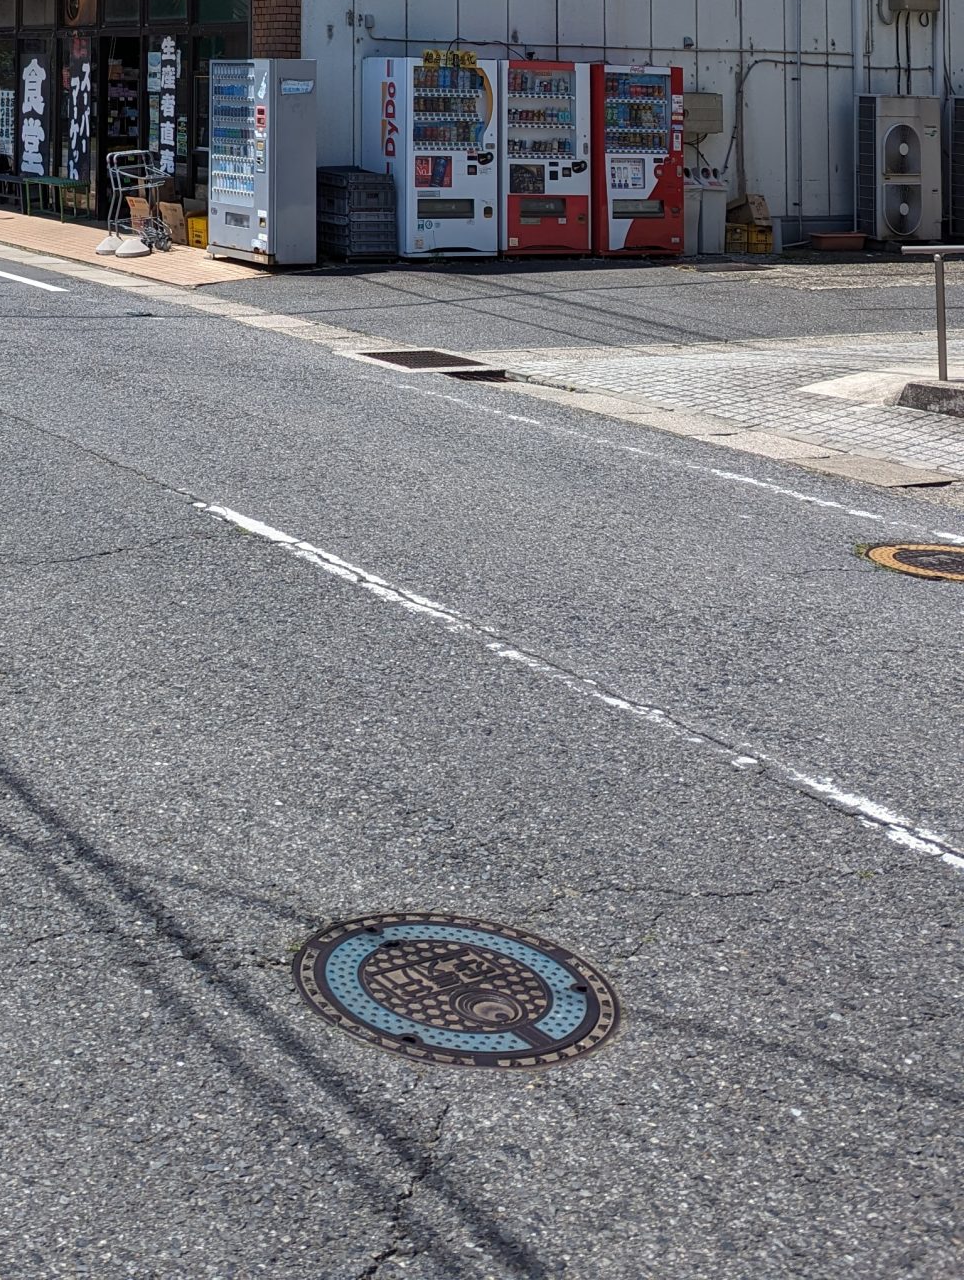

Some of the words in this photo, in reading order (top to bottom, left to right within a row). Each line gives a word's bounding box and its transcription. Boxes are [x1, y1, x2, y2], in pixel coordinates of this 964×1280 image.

[21, 58, 46, 176] 食堂
[69, 76, 80, 180] マーケット
[80, 62, 91, 153] スーパー
[160, 35, 176, 174] 生産者直売
